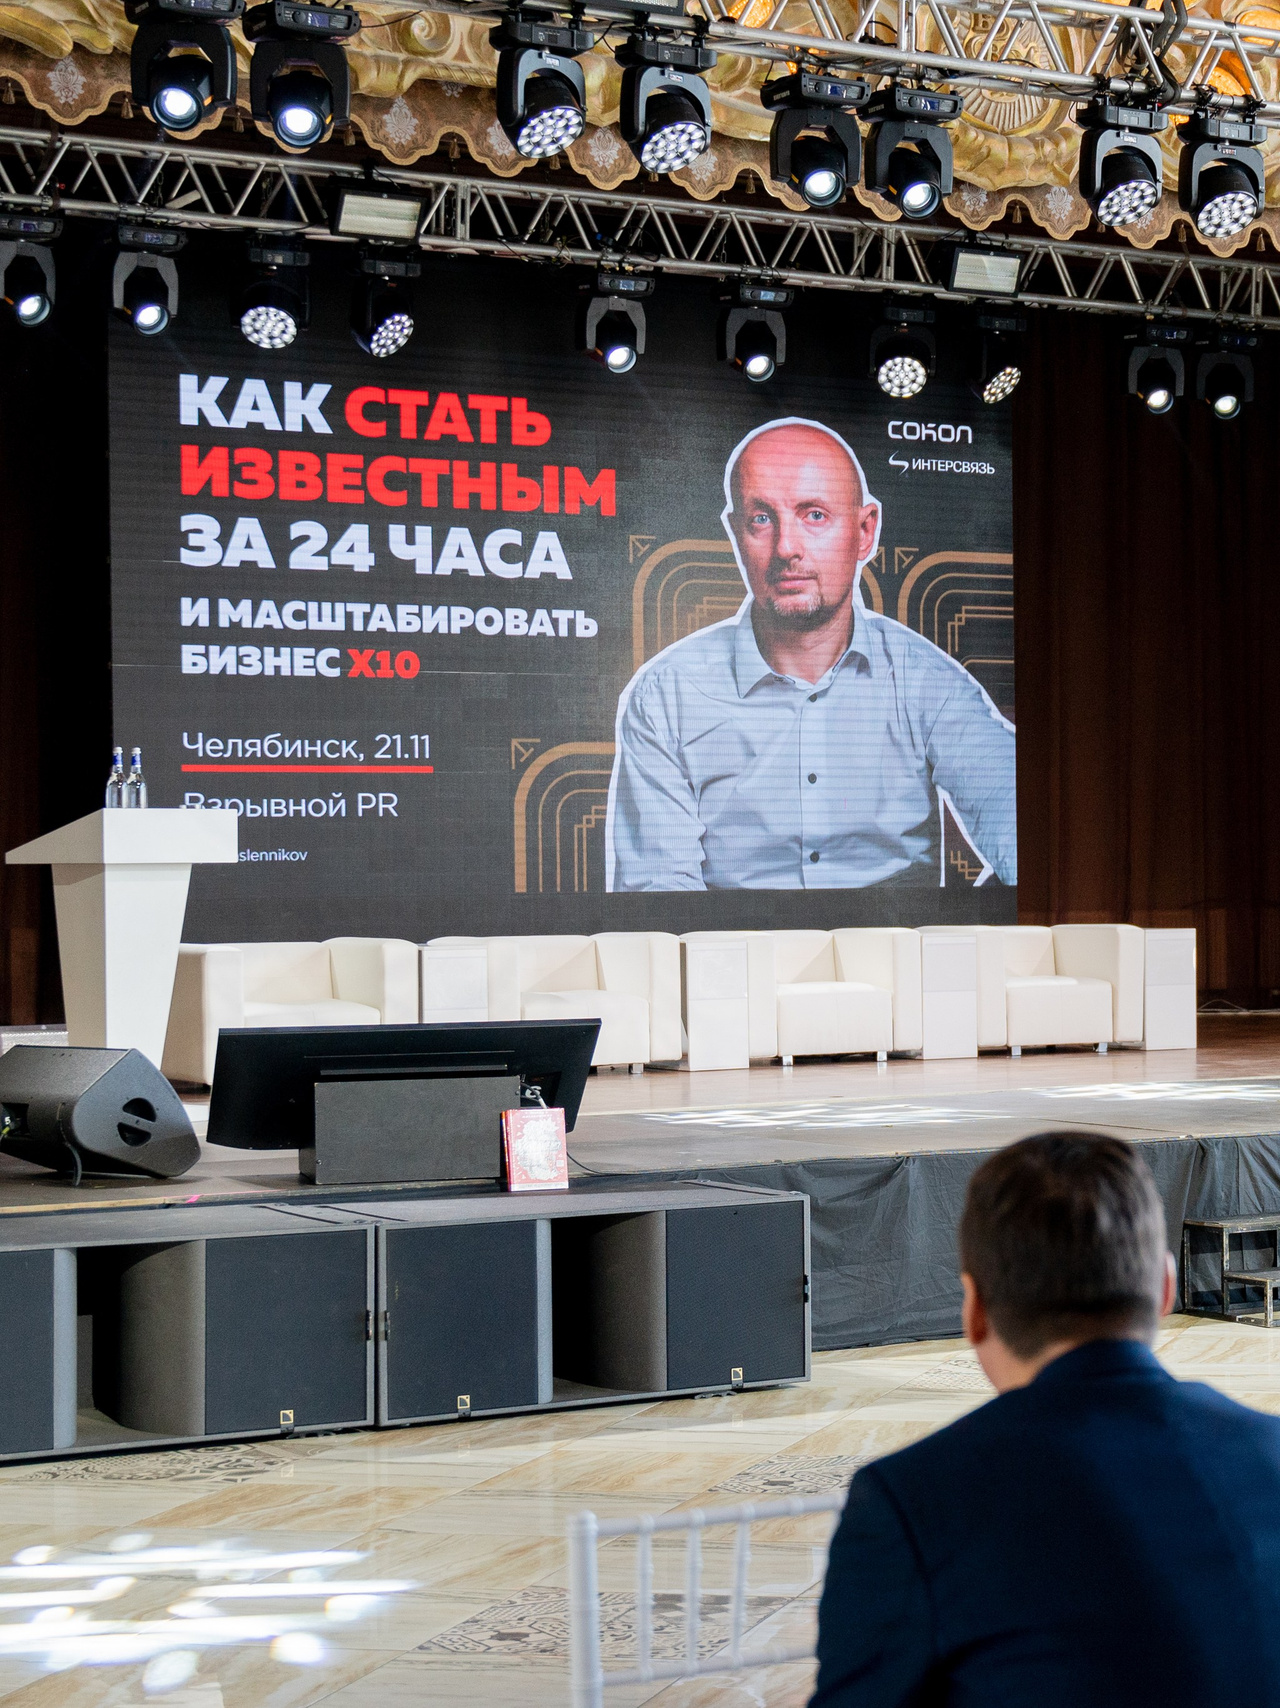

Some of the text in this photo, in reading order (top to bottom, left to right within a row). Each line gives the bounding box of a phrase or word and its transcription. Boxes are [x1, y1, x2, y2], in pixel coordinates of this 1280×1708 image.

[179, 373, 552, 447] КАК СТАТЬ
[180, 445, 617, 517] ИЗВЕСТНЫМ
[911, 458, 996, 475] ИНТЕРСВЯЗЬ
[179, 513, 574, 580] ЗА 24 ЧАСА
[180, 597, 599, 639] И МАСШТАБИРОВАТЬ
[181, 644, 341, 678] БИЗНЕС
[181, 731, 431, 762] Челябинск, 21.11
[357, 792, 399, 818] PR
